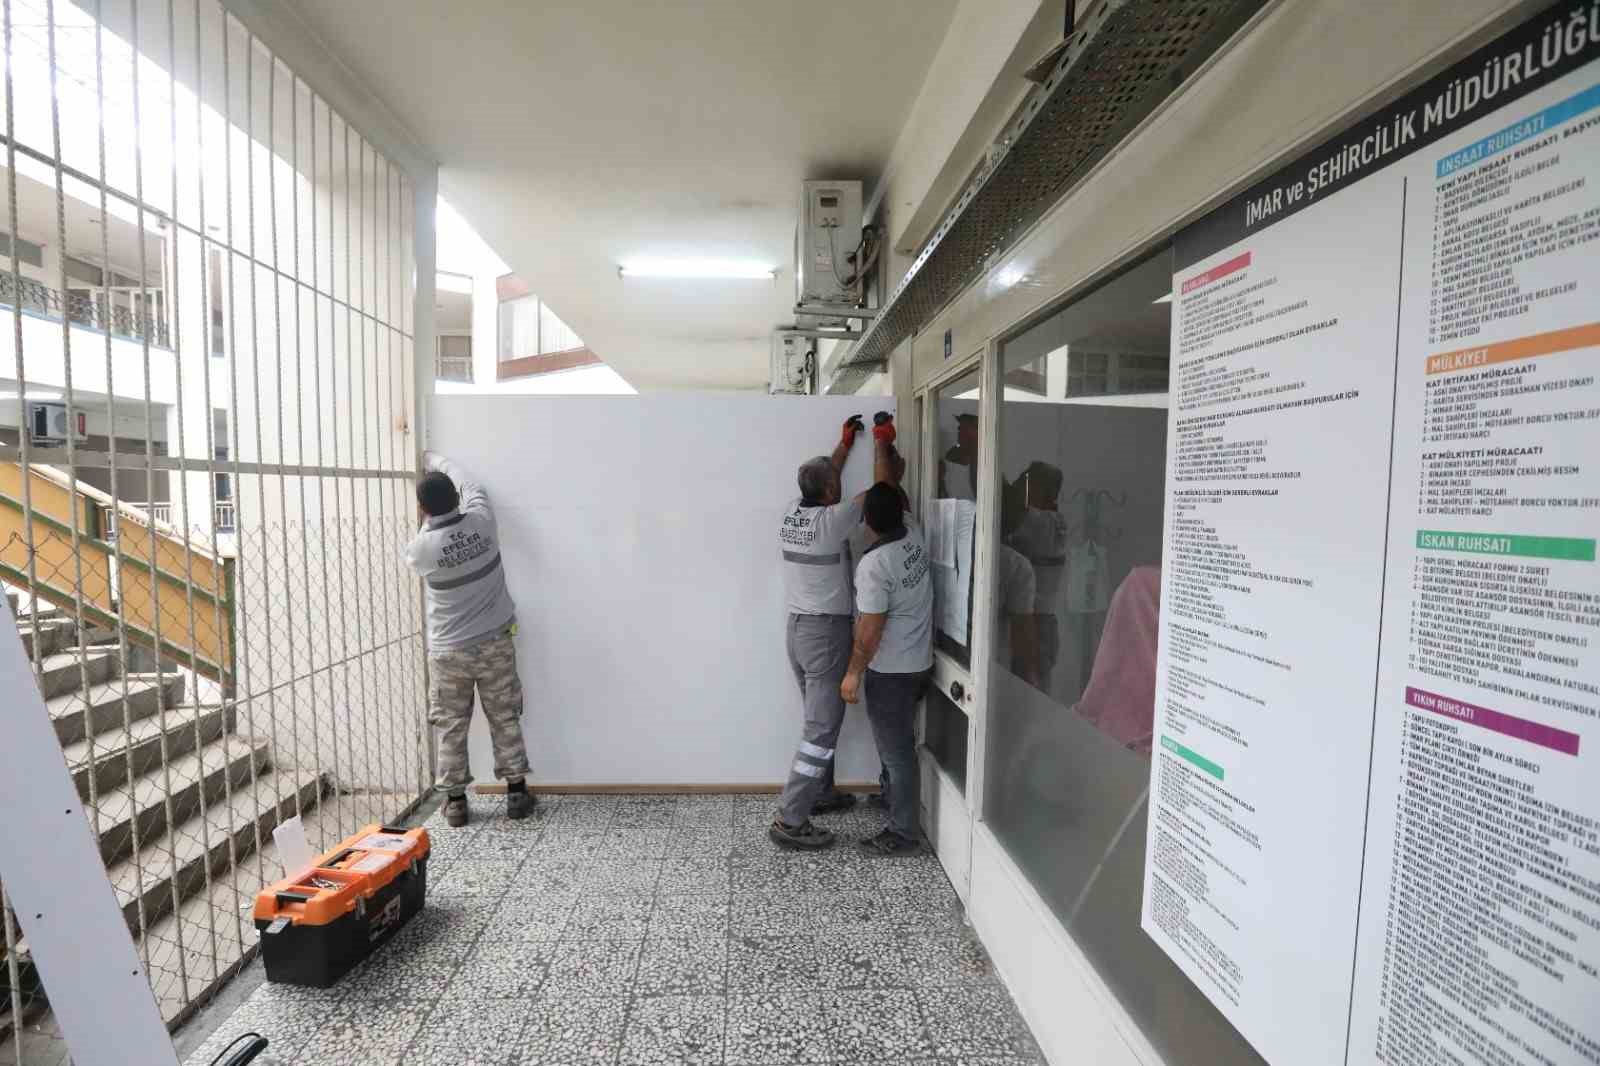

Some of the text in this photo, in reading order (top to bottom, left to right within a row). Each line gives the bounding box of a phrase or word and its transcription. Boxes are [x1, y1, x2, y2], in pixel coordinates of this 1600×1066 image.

[1246, 188, 1282, 227] İMAR
[1286, 181, 1303, 205] ve
[1307, 110, 1416, 199] ŞEHİRCİLİK
[1431, 349, 1488, 371] MÜLKİYET
[1426, 379, 1442, 389] KAT
[1481, 363, 1537, 380] MÜRACAATI
[1422, 446, 1543, 461] KAT MÜLKİYETİ MÜRACAATI
[1421, 533, 1512, 554] İSKAN RUHSATI
[1437, 698, 1475, 720] RUHSATI
